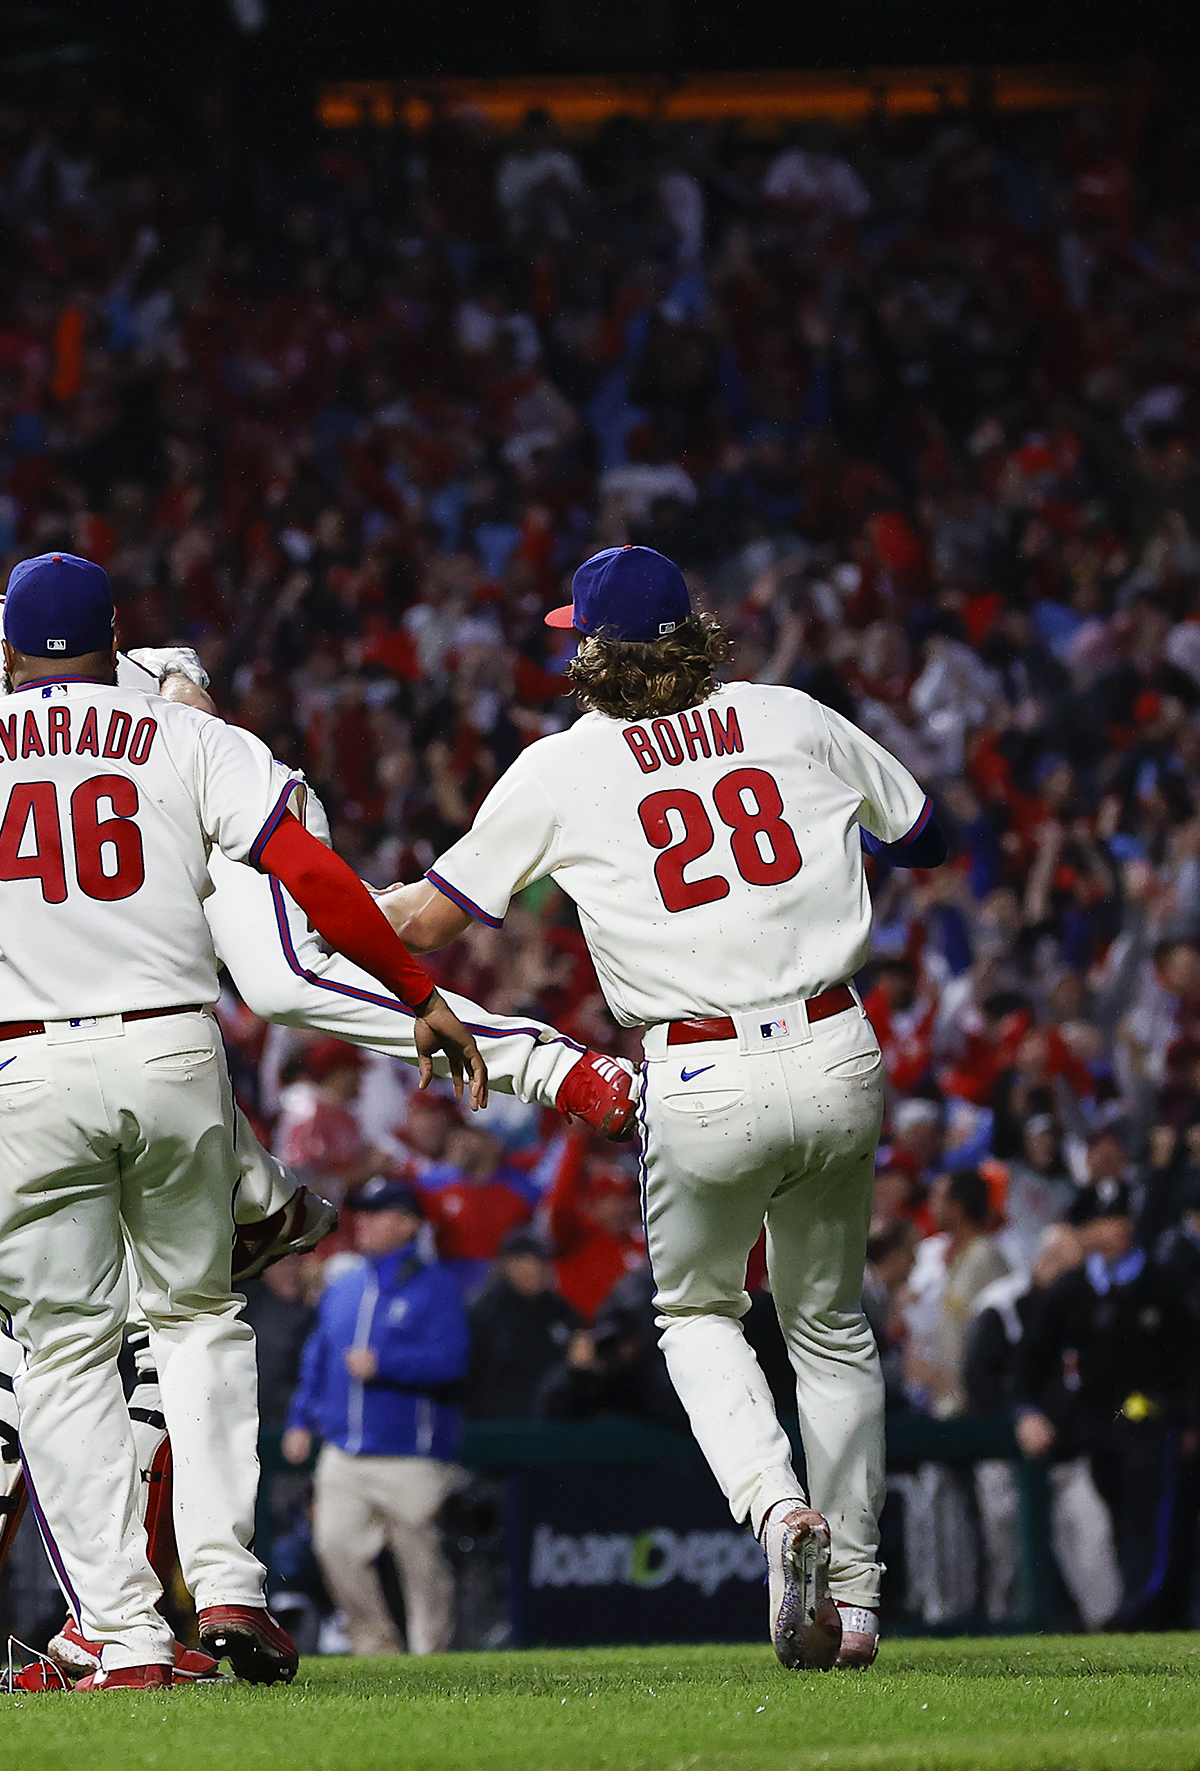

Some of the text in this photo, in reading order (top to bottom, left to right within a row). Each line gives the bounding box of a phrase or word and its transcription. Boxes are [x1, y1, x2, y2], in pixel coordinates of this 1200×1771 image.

[622, 706, 744, 774] BOHM
[637, 767, 804, 913] 28
[530, 1523, 768, 1596] loanDepo
